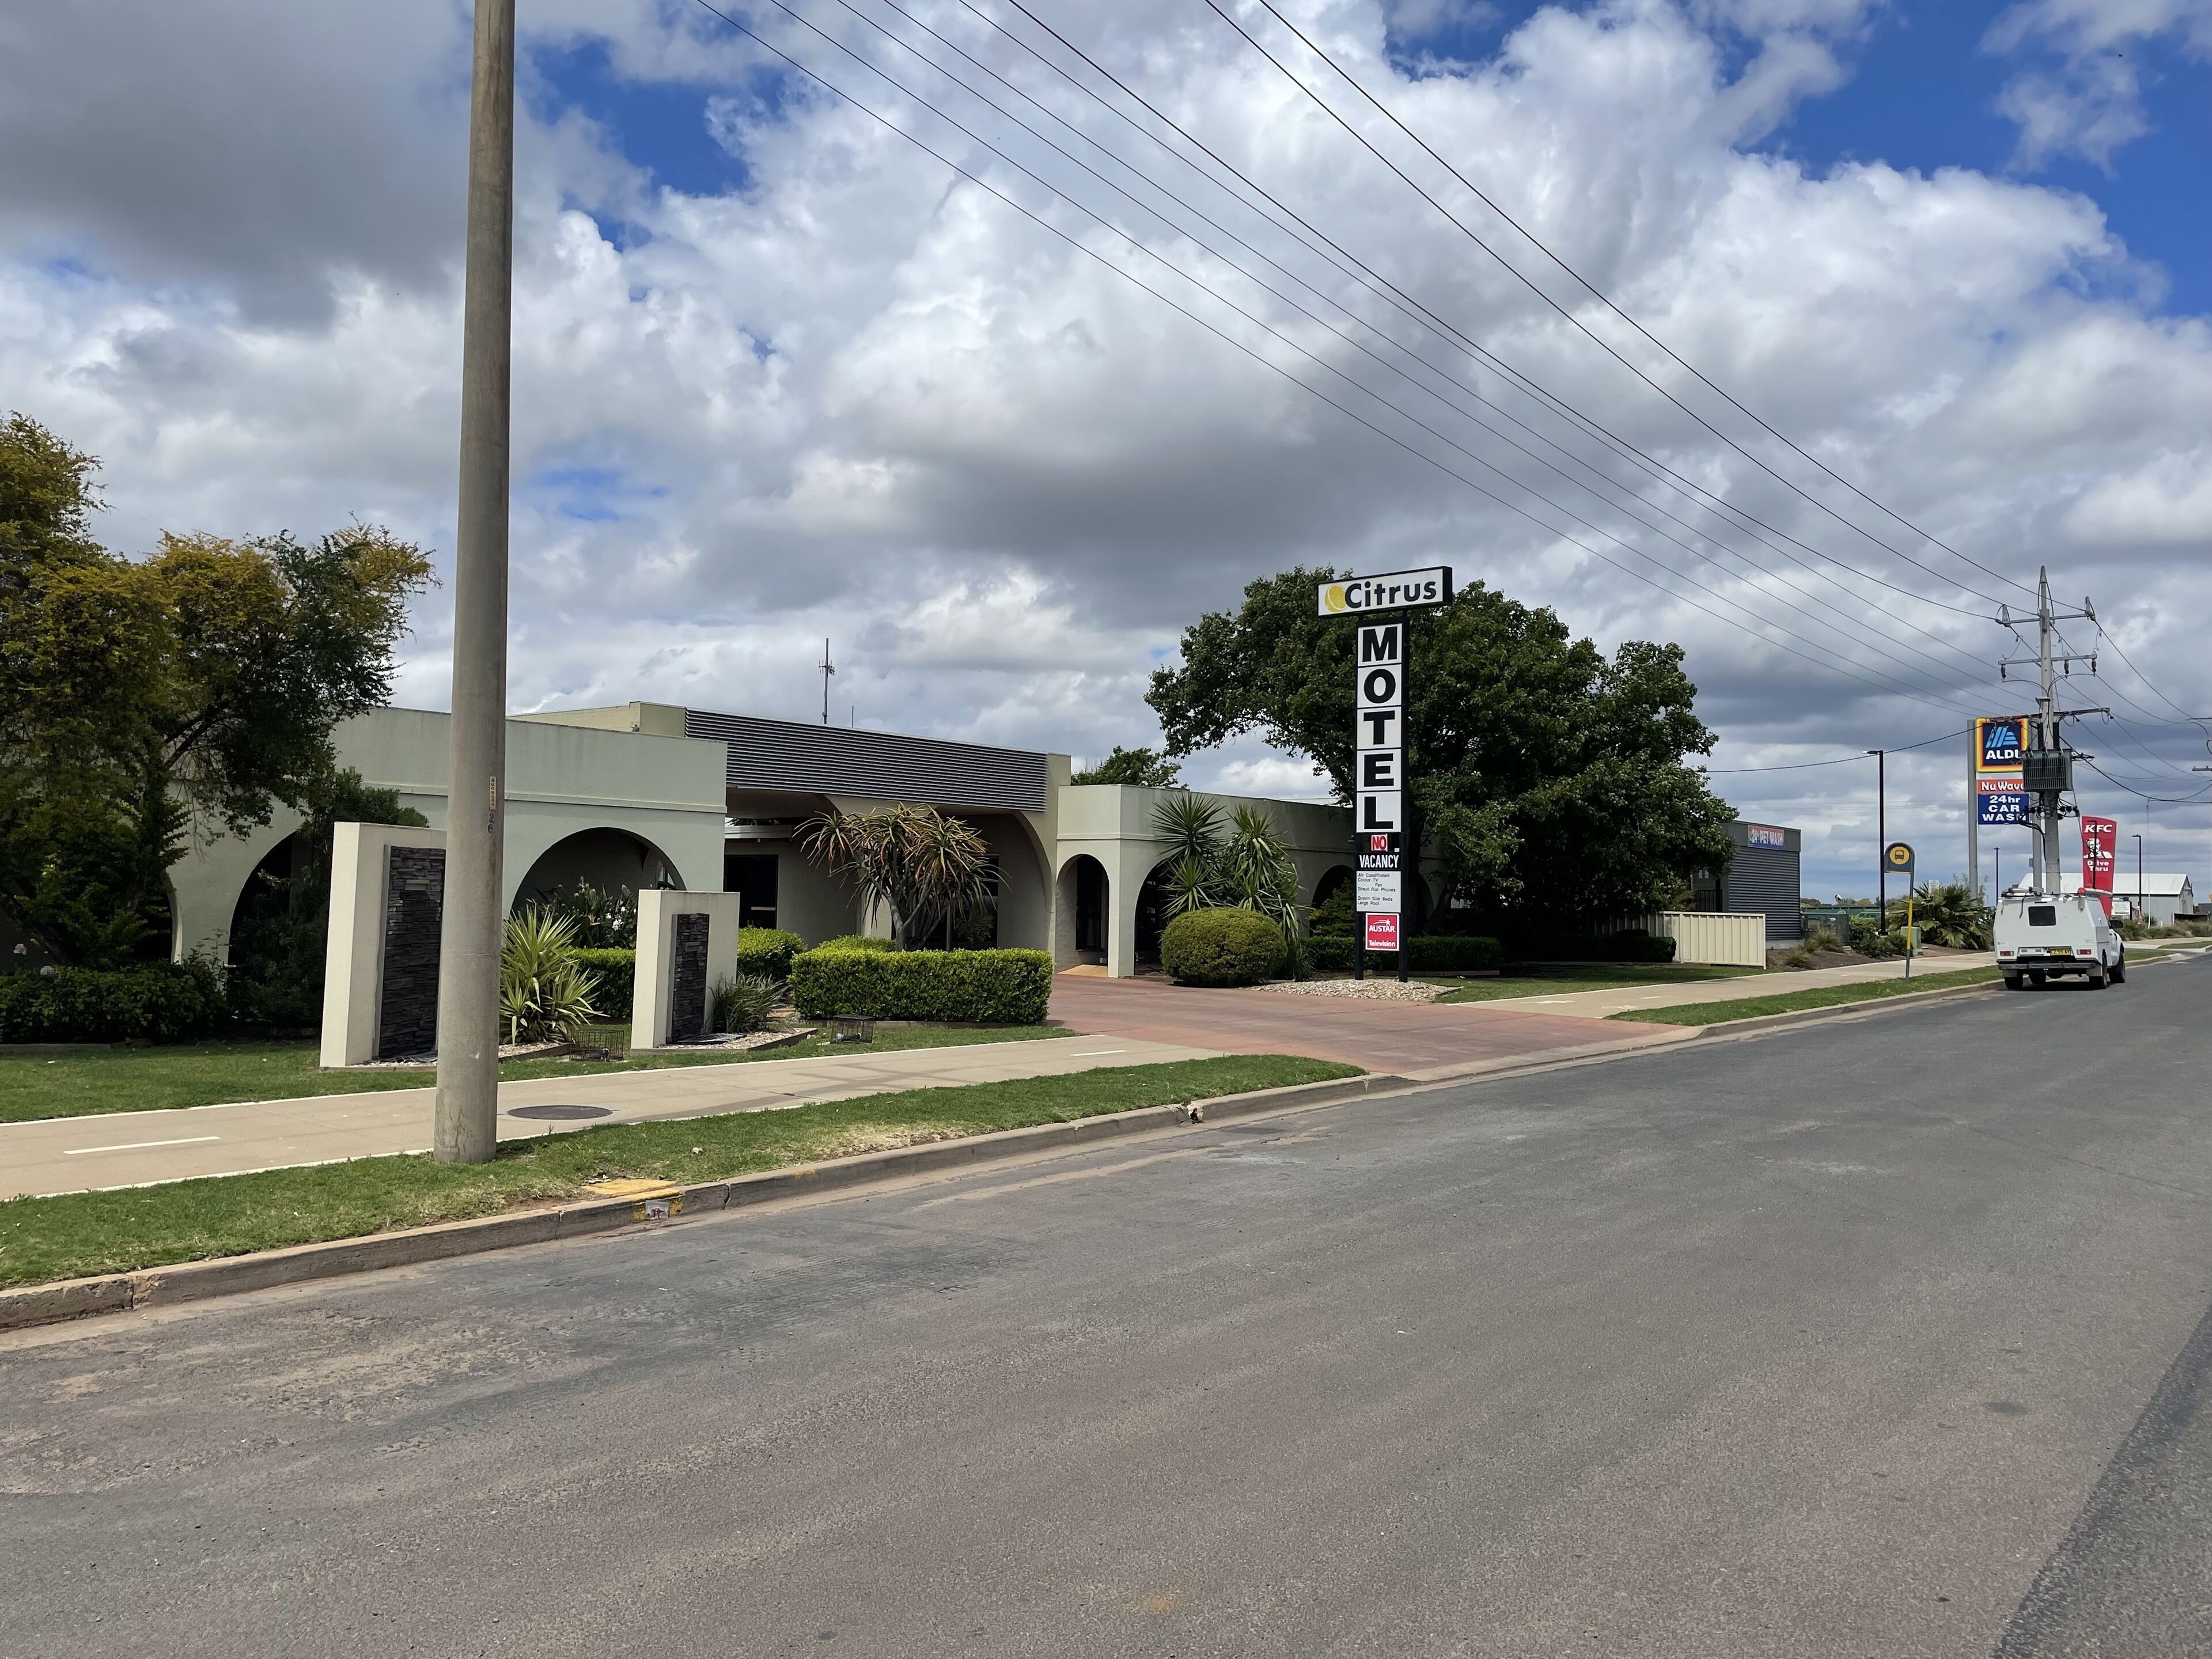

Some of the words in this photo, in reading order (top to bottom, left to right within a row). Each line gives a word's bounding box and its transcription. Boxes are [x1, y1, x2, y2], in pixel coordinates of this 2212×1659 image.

[1344, 581, 1437, 609] Citrus
[1362, 626, 1398, 830] MOTEL
[1986, 749, 2021, 760] ALDI
[1989, 795, 2021, 803] 24hr
[2084, 824, 2112, 833] KFC
[1372, 836, 1387, 850] NO
[1760, 830, 1769, 844] PET
[1770, 831, 1783, 846] WASH
[1359, 854, 1399, 868] VACANCY
[1368, 925, 1396, 933] AUSTAR
